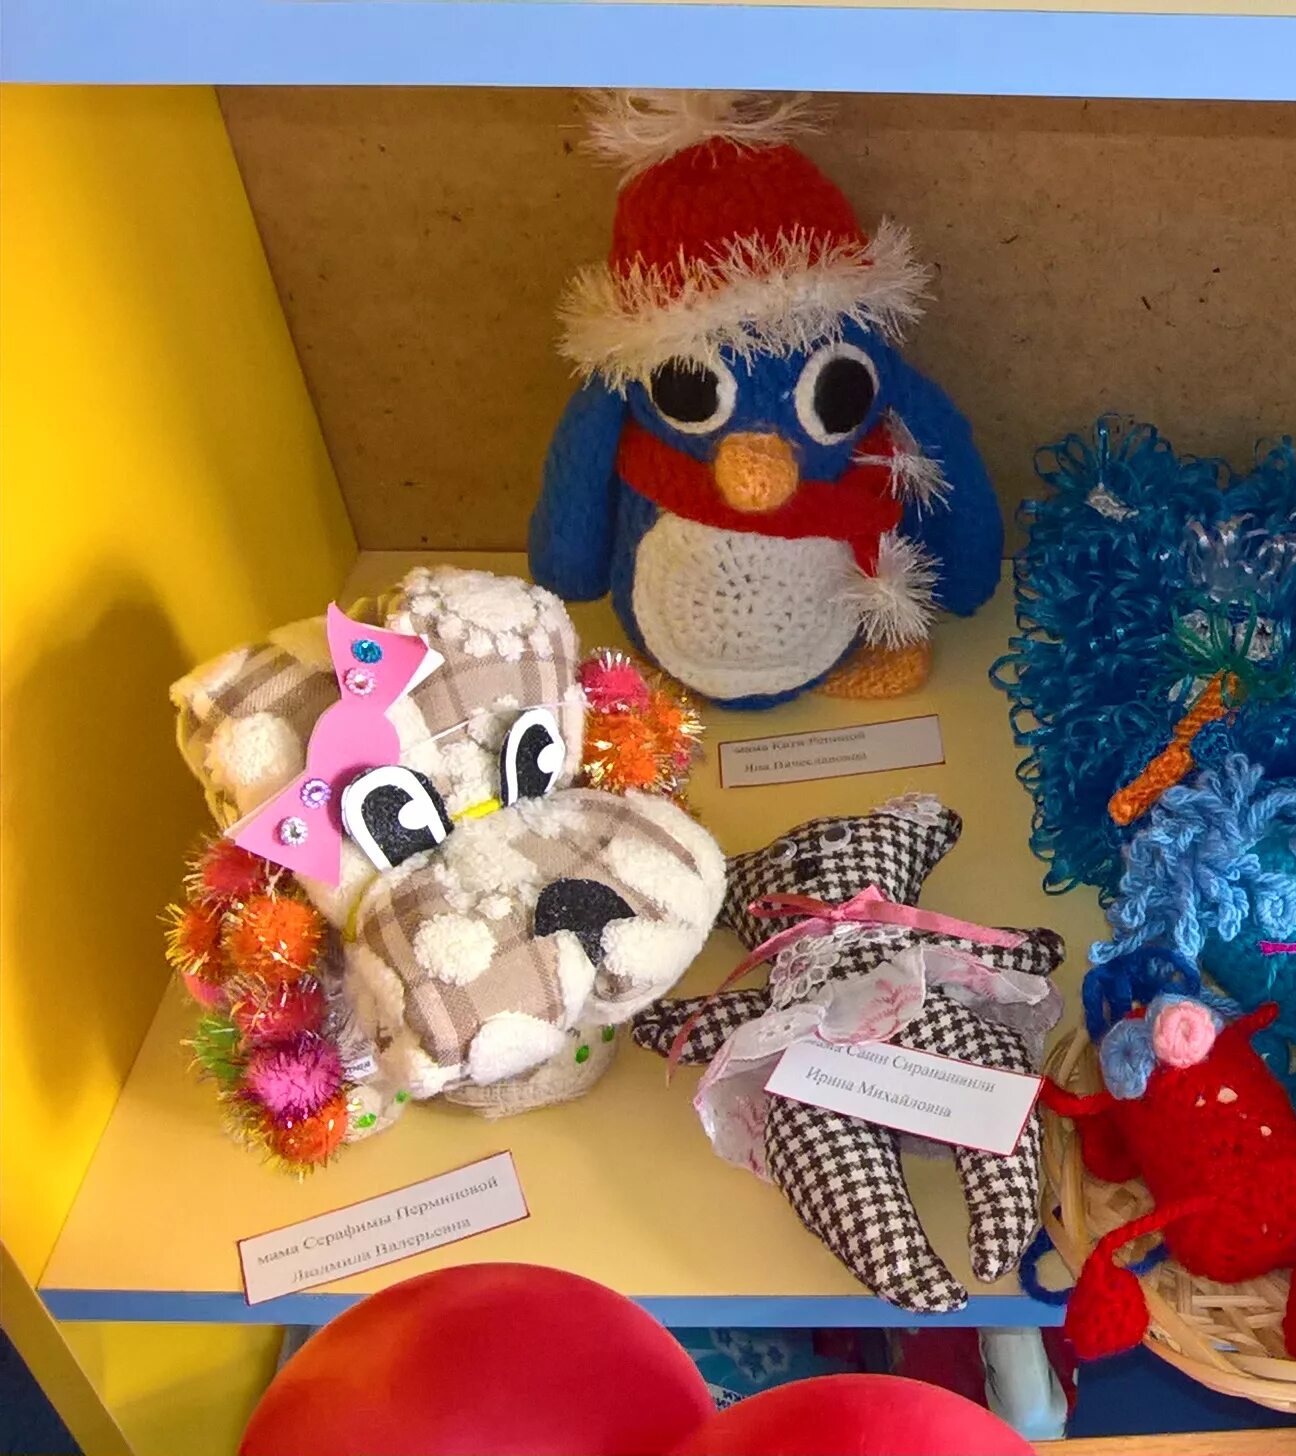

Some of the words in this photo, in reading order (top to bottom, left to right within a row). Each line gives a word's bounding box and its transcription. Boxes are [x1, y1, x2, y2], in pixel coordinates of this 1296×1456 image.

[846, 1044, 890, 1067] Саши
[805, 1065, 859, 1091] Ирина
[858, 1080, 952, 1118] Михайловна
[256, 1244, 300, 1267] мама
[302, 1214, 391, 1249] Серафимы
[291, 1250, 372, 1284] Людмила
